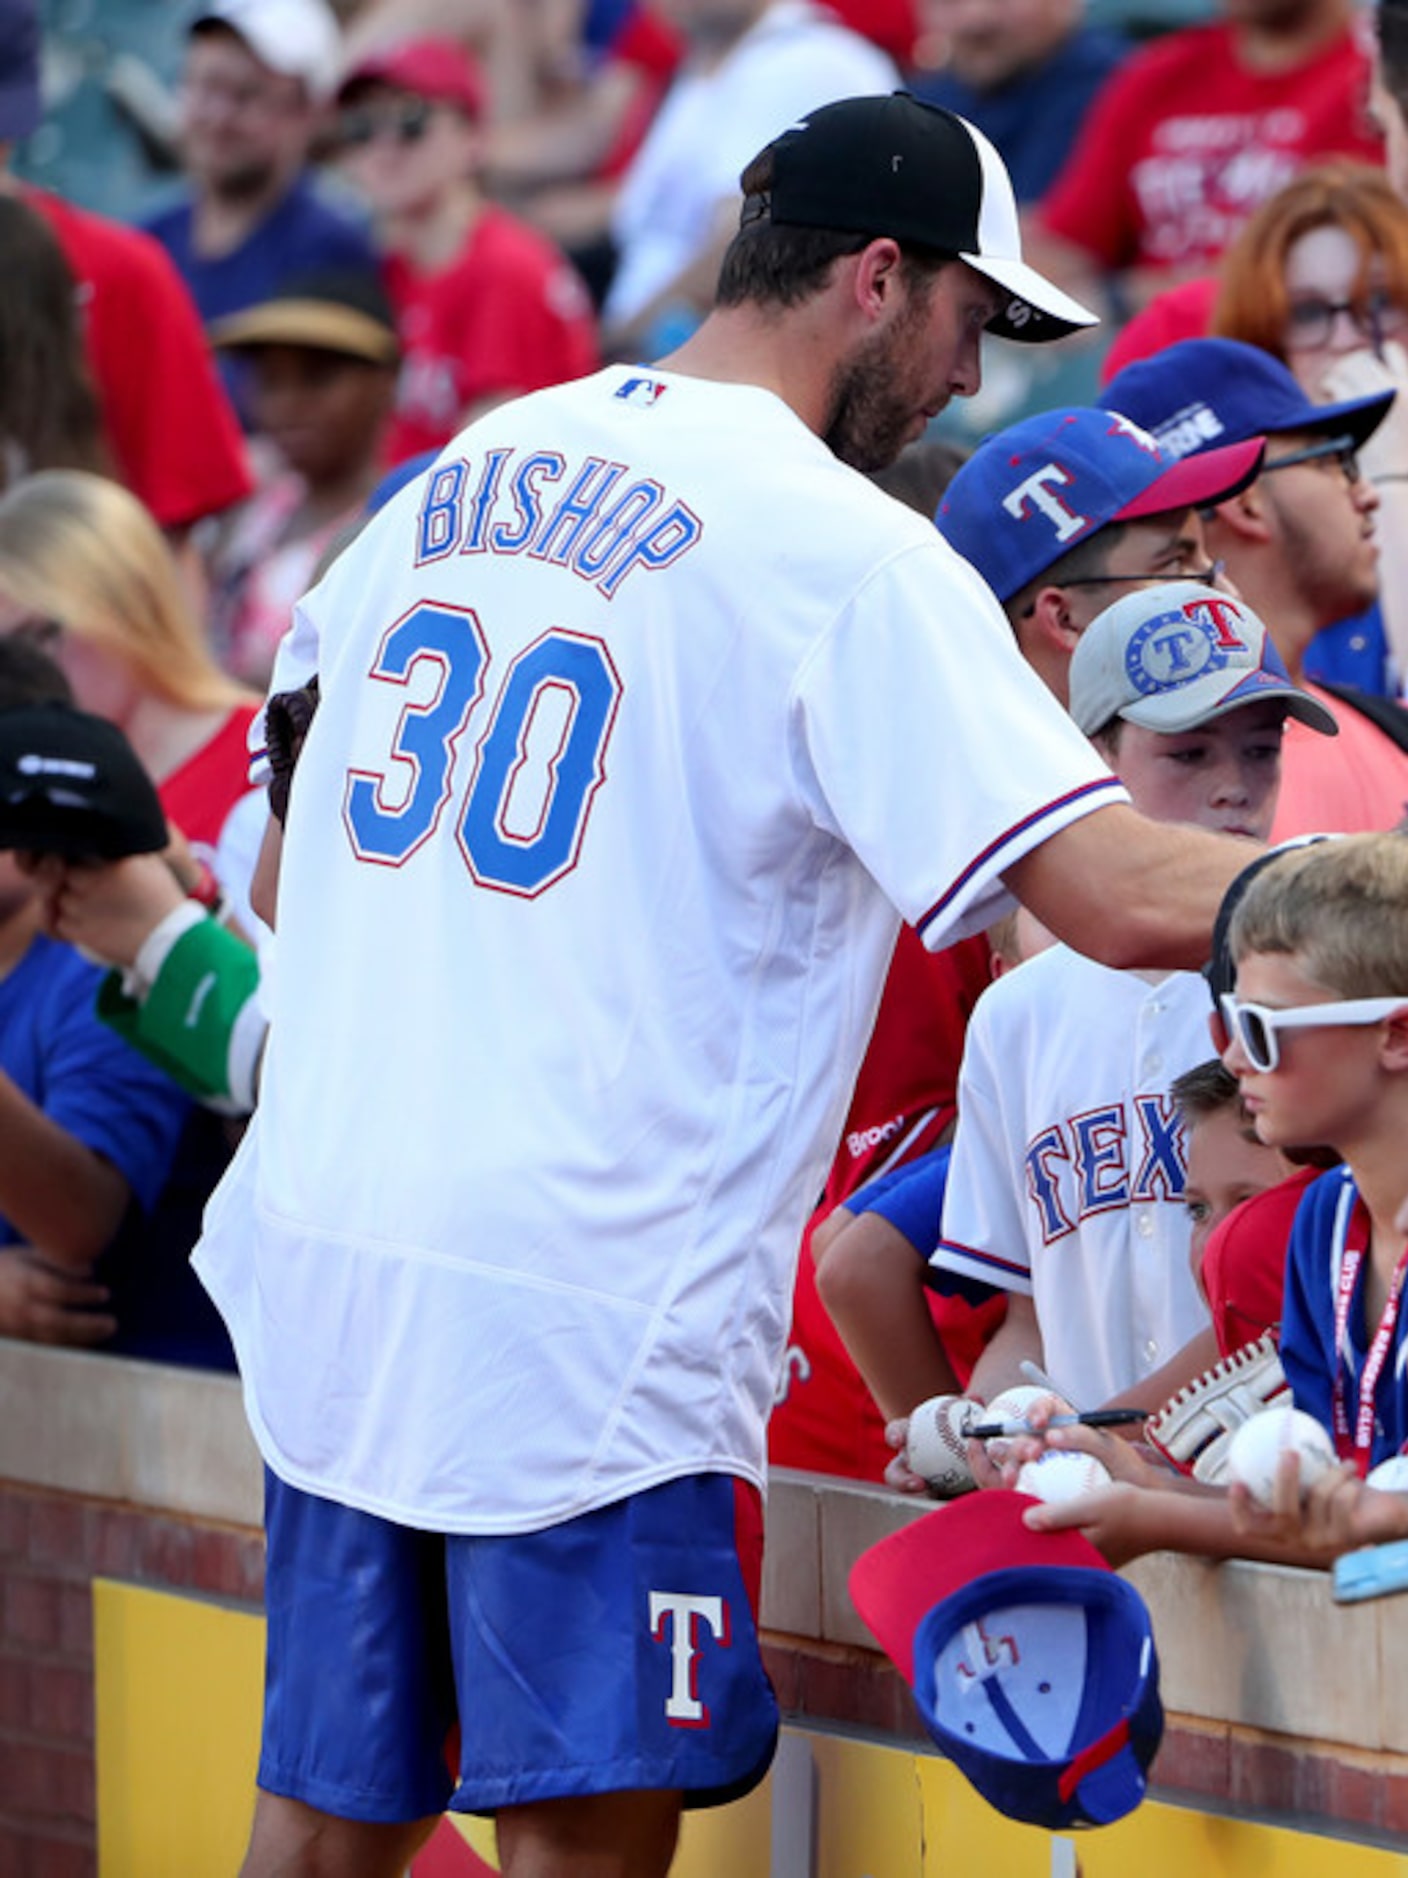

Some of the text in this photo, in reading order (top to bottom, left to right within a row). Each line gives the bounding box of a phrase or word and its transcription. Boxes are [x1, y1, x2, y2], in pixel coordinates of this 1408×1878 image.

[414, 447, 704, 602] BISHOP
[1002, 461, 1096, 545] T
[1152, 630, 1194, 673] T
[1182, 598, 1249, 652] T
[342, 598, 625, 901] 30
[648, 1589, 733, 1730] T
